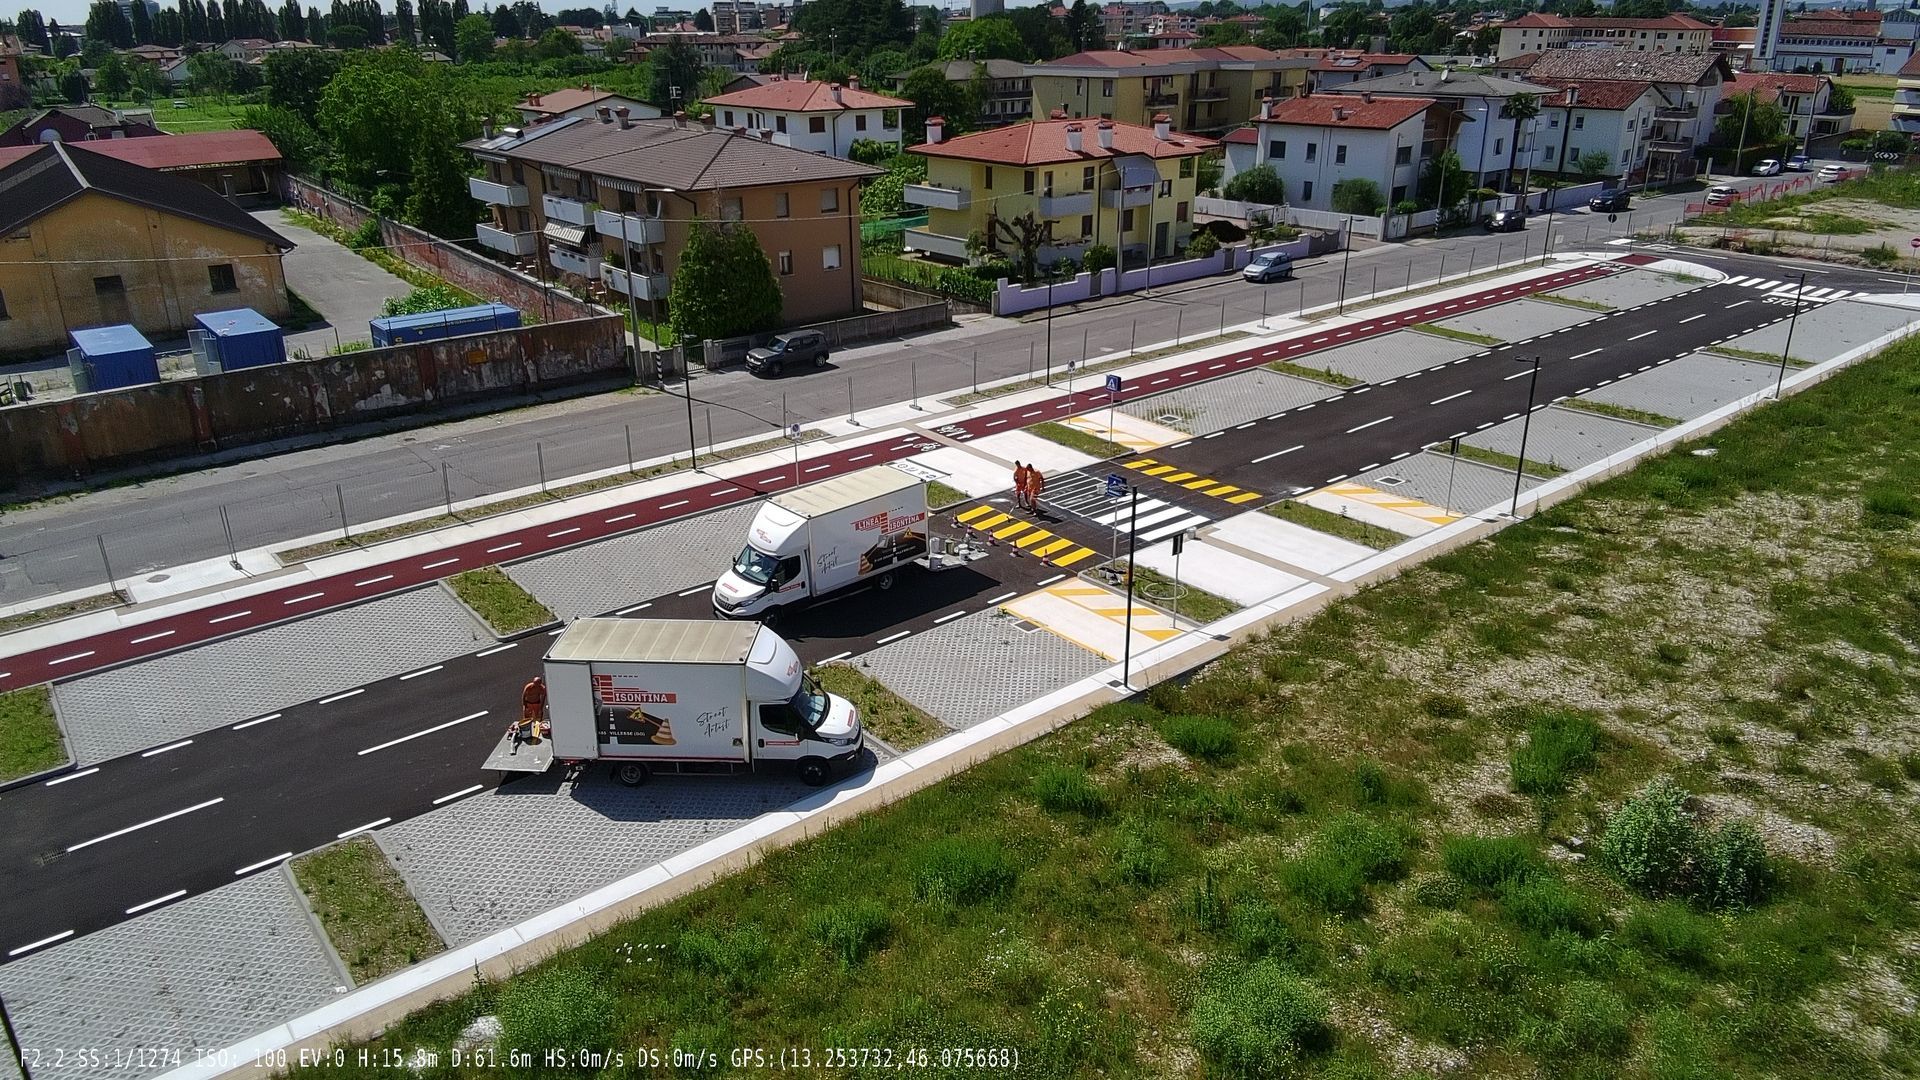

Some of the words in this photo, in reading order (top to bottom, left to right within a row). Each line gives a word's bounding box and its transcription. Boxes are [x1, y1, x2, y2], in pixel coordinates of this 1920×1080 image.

[1762, 297, 1808, 306] STOP
[858, 517, 880, 529] LINEA
[890, 515, 920, 530] ISONTINA
[615, 693, 668, 703] ISONTINA
